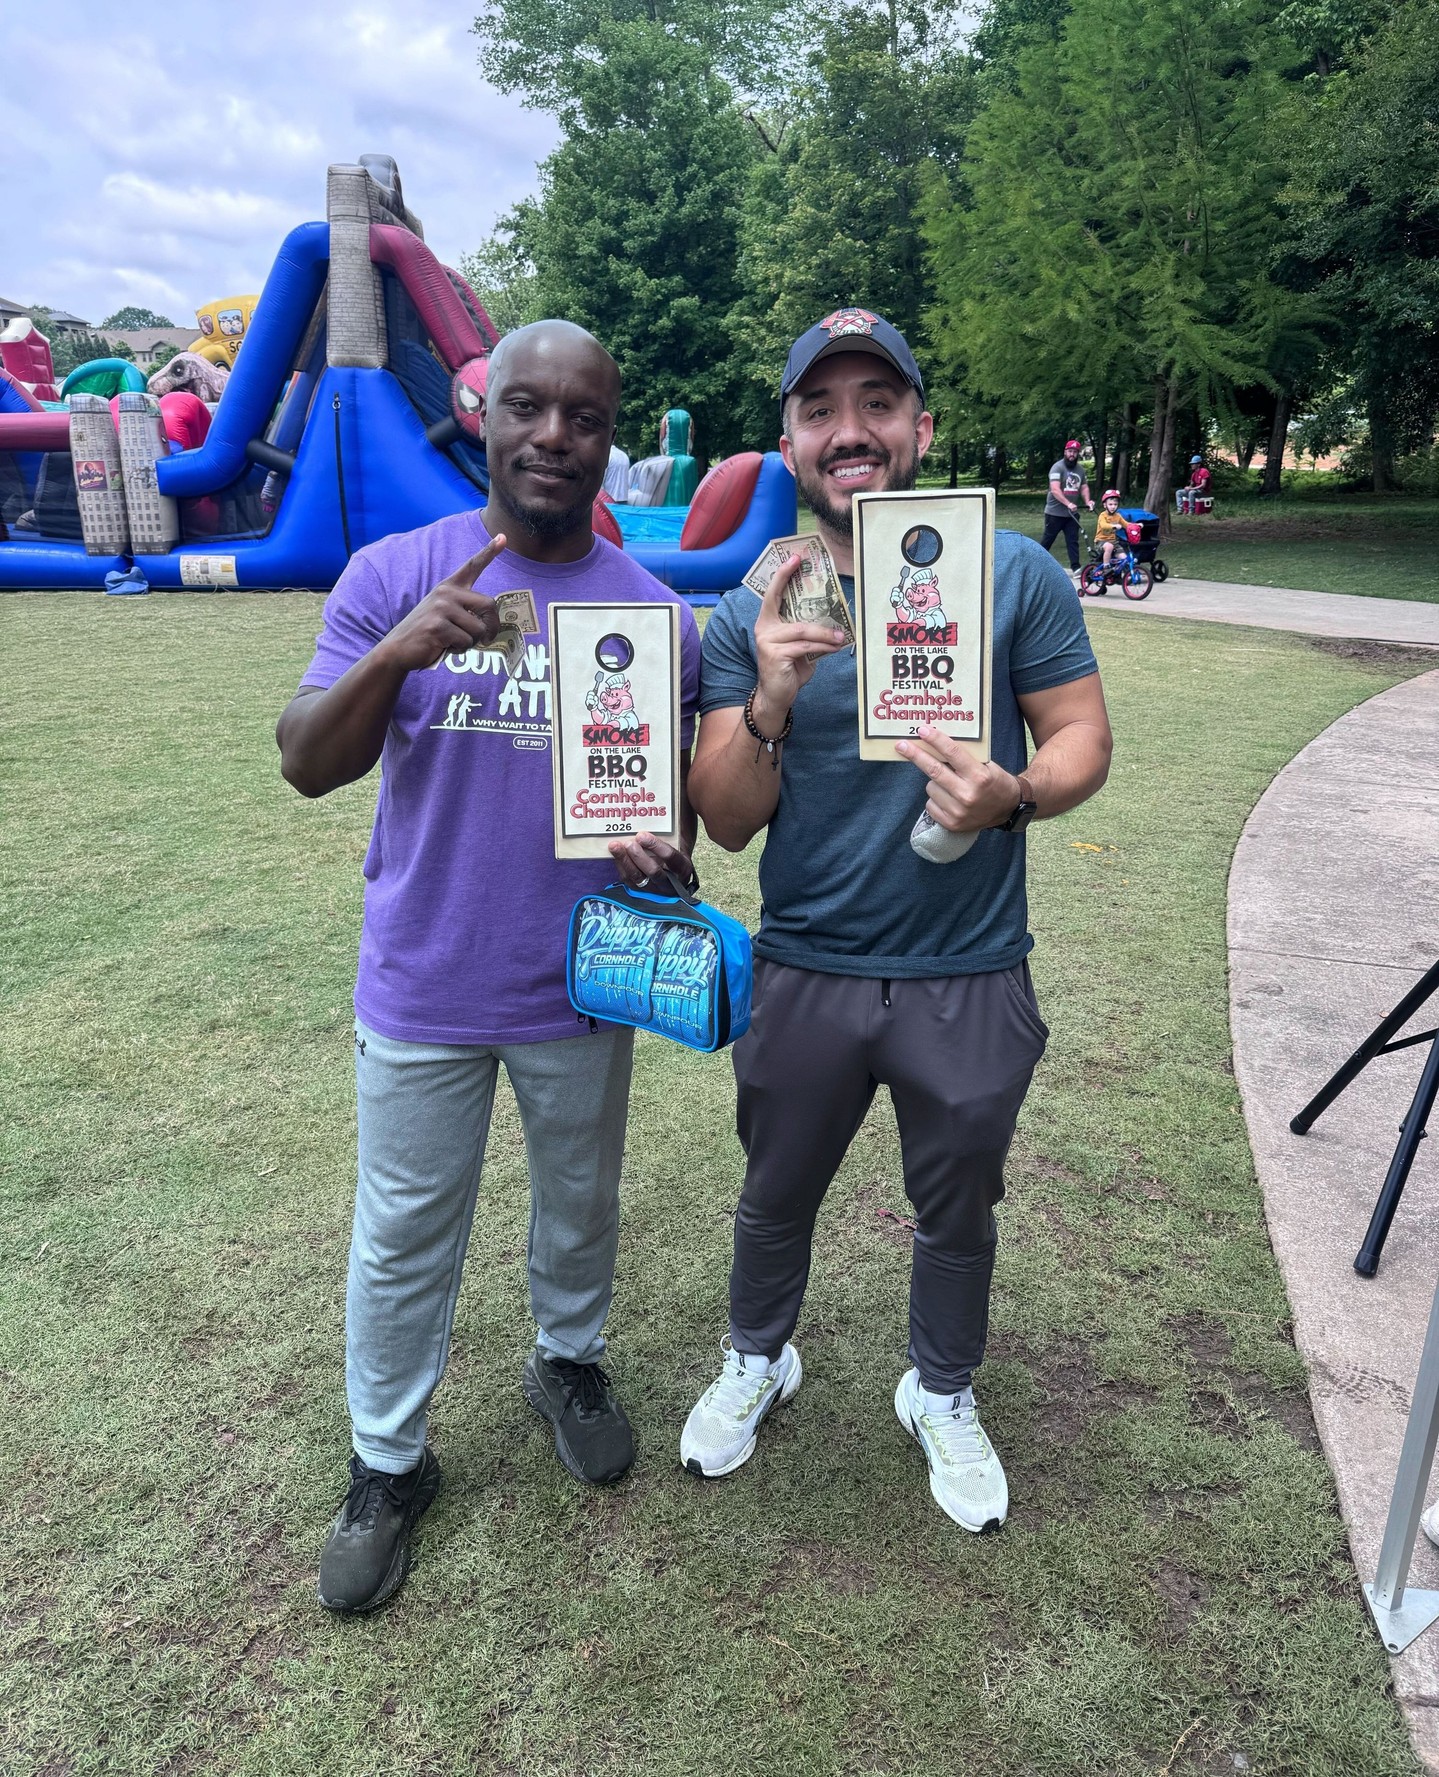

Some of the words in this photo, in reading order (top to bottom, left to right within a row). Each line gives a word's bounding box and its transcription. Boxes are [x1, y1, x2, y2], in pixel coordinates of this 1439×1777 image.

[887, 624, 953, 644] SMOKE
[927, 646, 948, 654] LAKE
[891, 654, 955, 684] BBQ
[892, 680, 944, 690] FESTIVAL
[879, 689, 963, 706] Cornhole
[873, 704, 975, 724] Champions
[472, 719, 497, 728] WHY
[498, 721, 525, 730] WAIT
[583, 726, 645, 745] SMOKE
[588, 755, 648, 782] BBQ
[588, 779, 638, 788] FESTIVAL
[576, 787, 656, 804] Cornhole
[570, 802, 667, 821] Champions
[605, 823, 632, 832] 2026
[577, 915, 656, 954] Drippy
[594, 954, 645, 967] CORNHOLE
[594, 980, 644, 996] DOWNPOUR
[653, 1009, 703, 1030] OWNPOUR
